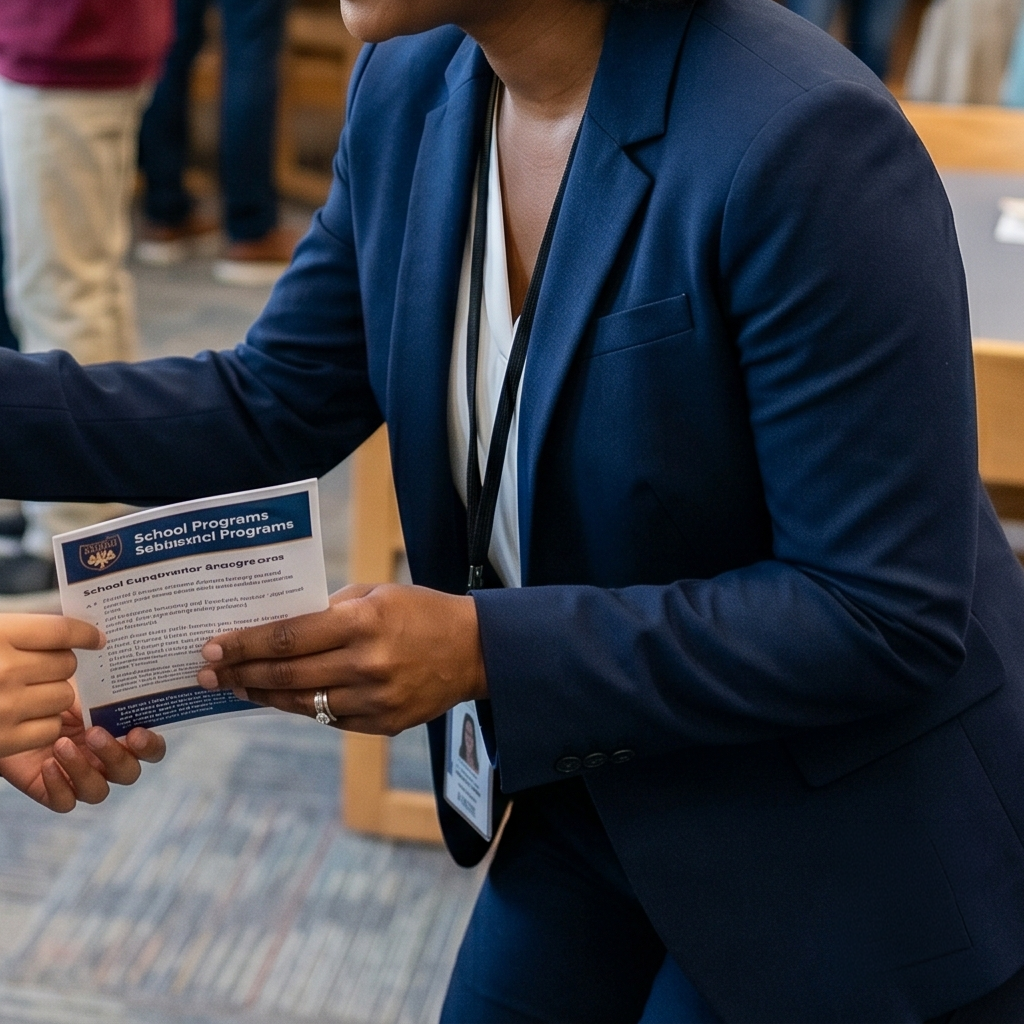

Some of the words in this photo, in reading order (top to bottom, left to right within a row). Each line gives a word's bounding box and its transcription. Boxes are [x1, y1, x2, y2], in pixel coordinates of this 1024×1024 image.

[134, 523, 187, 544] School
[192, 512, 269, 532] Programs
[220, 520, 294, 540] Programs
[83, 580, 124, 597] School
